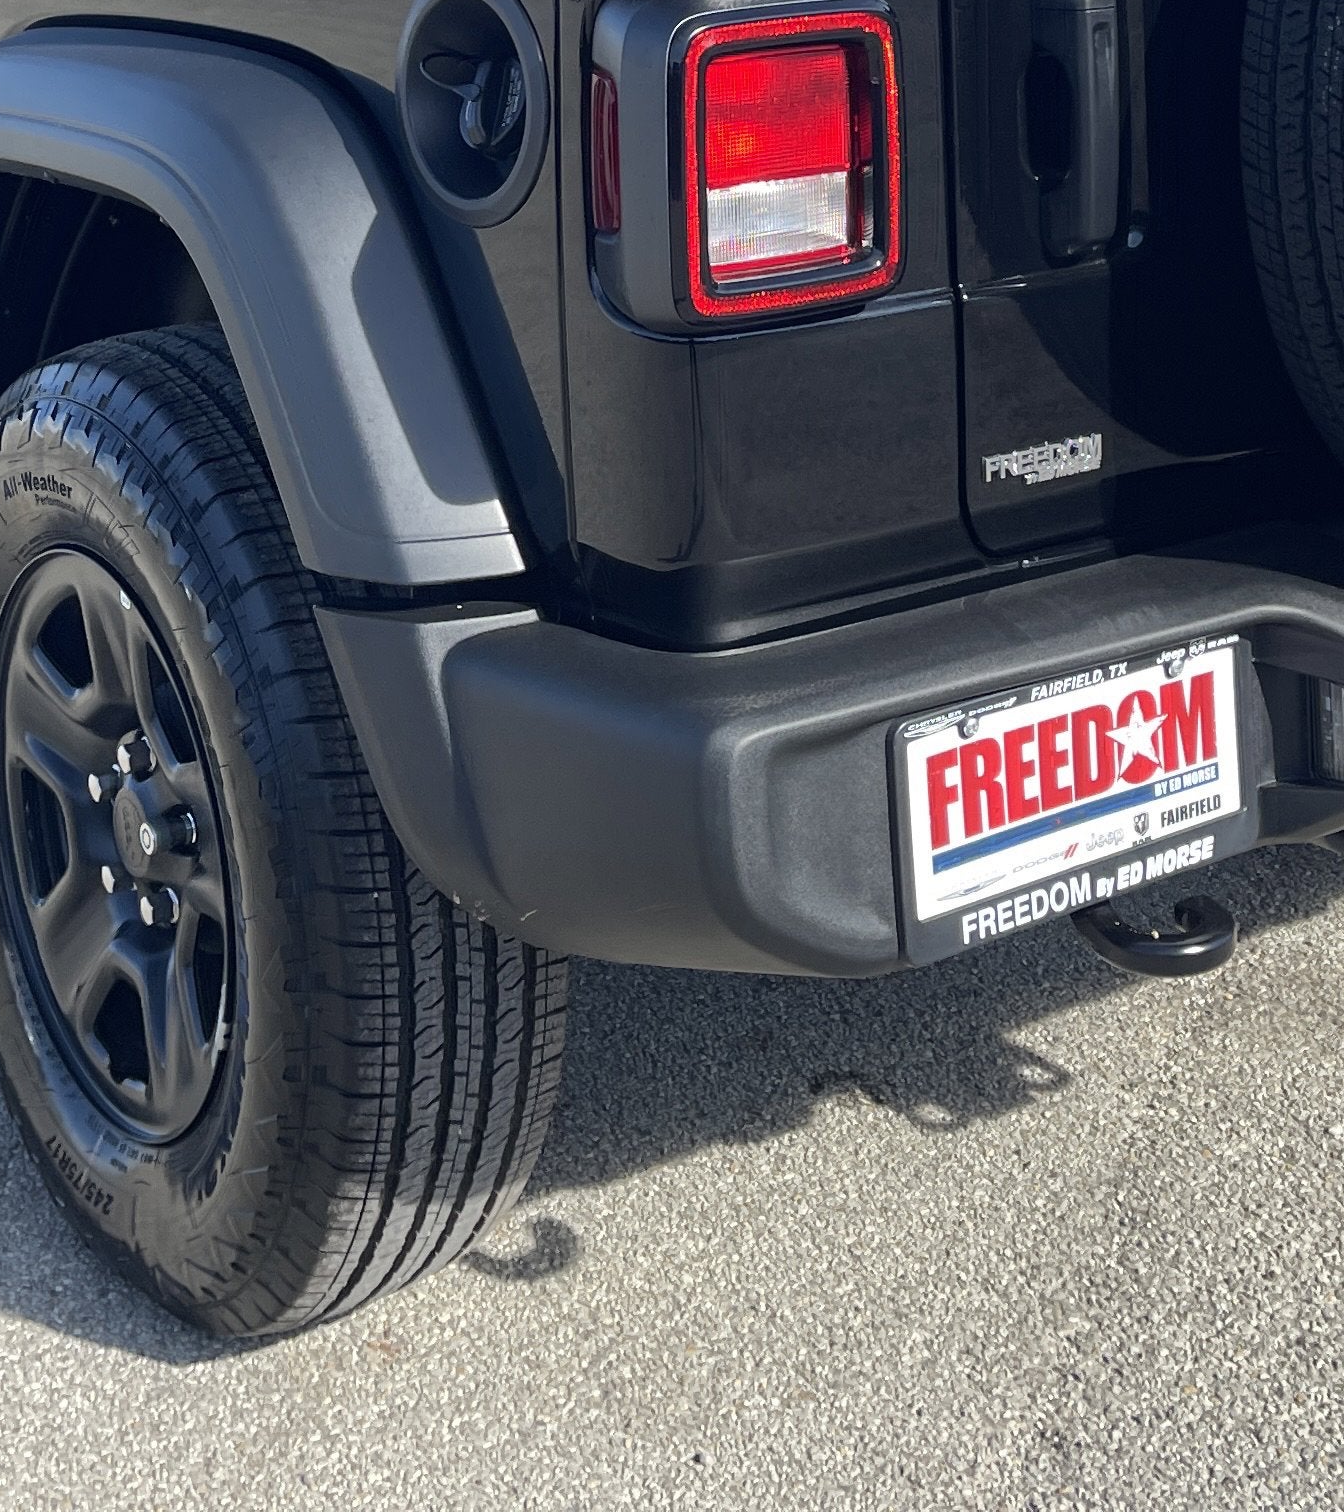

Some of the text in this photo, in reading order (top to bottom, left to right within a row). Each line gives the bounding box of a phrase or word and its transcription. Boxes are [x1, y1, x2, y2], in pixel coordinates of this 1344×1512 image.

[3, 471, 73, 501] All-Weather
[1156, 647, 1186, 664] Jeep
[1030, 662, 1128, 702] FAIRFIELD, TX
[926, 671, 1218, 851] FREEDOM
[1154, 766, 1217, 797] BY ED MORSE
[1160, 794, 1222, 828] FAIRFIELD
[1086, 828, 1125, 852] Jeep
[962, 872, 1092, 945] FREEDOM
[1117, 861, 1143, 891] ED
[1146, 836, 1215, 880] MORSE
[45, 1135, 114, 1216] 245/75R17
